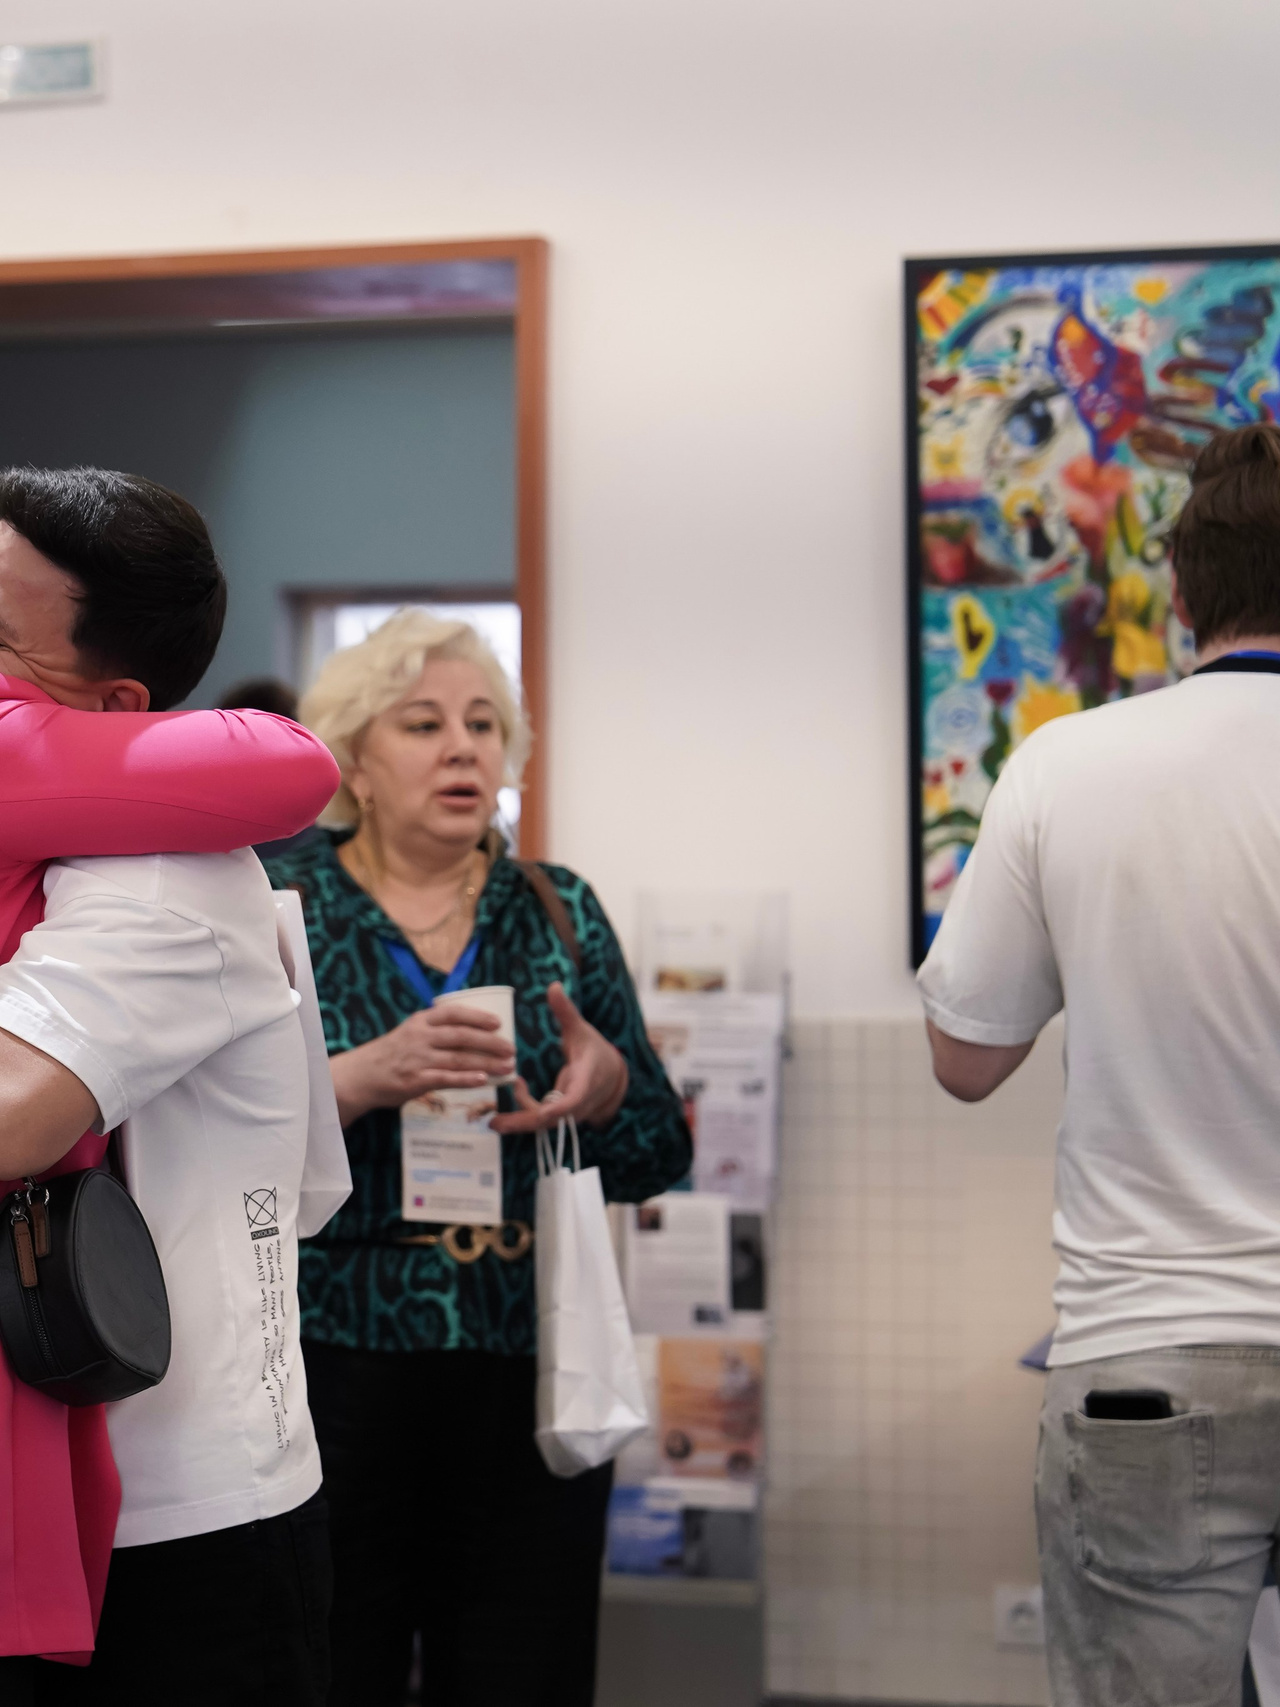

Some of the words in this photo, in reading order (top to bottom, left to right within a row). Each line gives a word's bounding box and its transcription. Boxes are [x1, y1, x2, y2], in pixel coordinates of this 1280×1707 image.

[253, 1243, 266, 1282] LIVING
[269, 1395, 278, 1408] IN
[274, 1411, 284, 1449] LIVING
